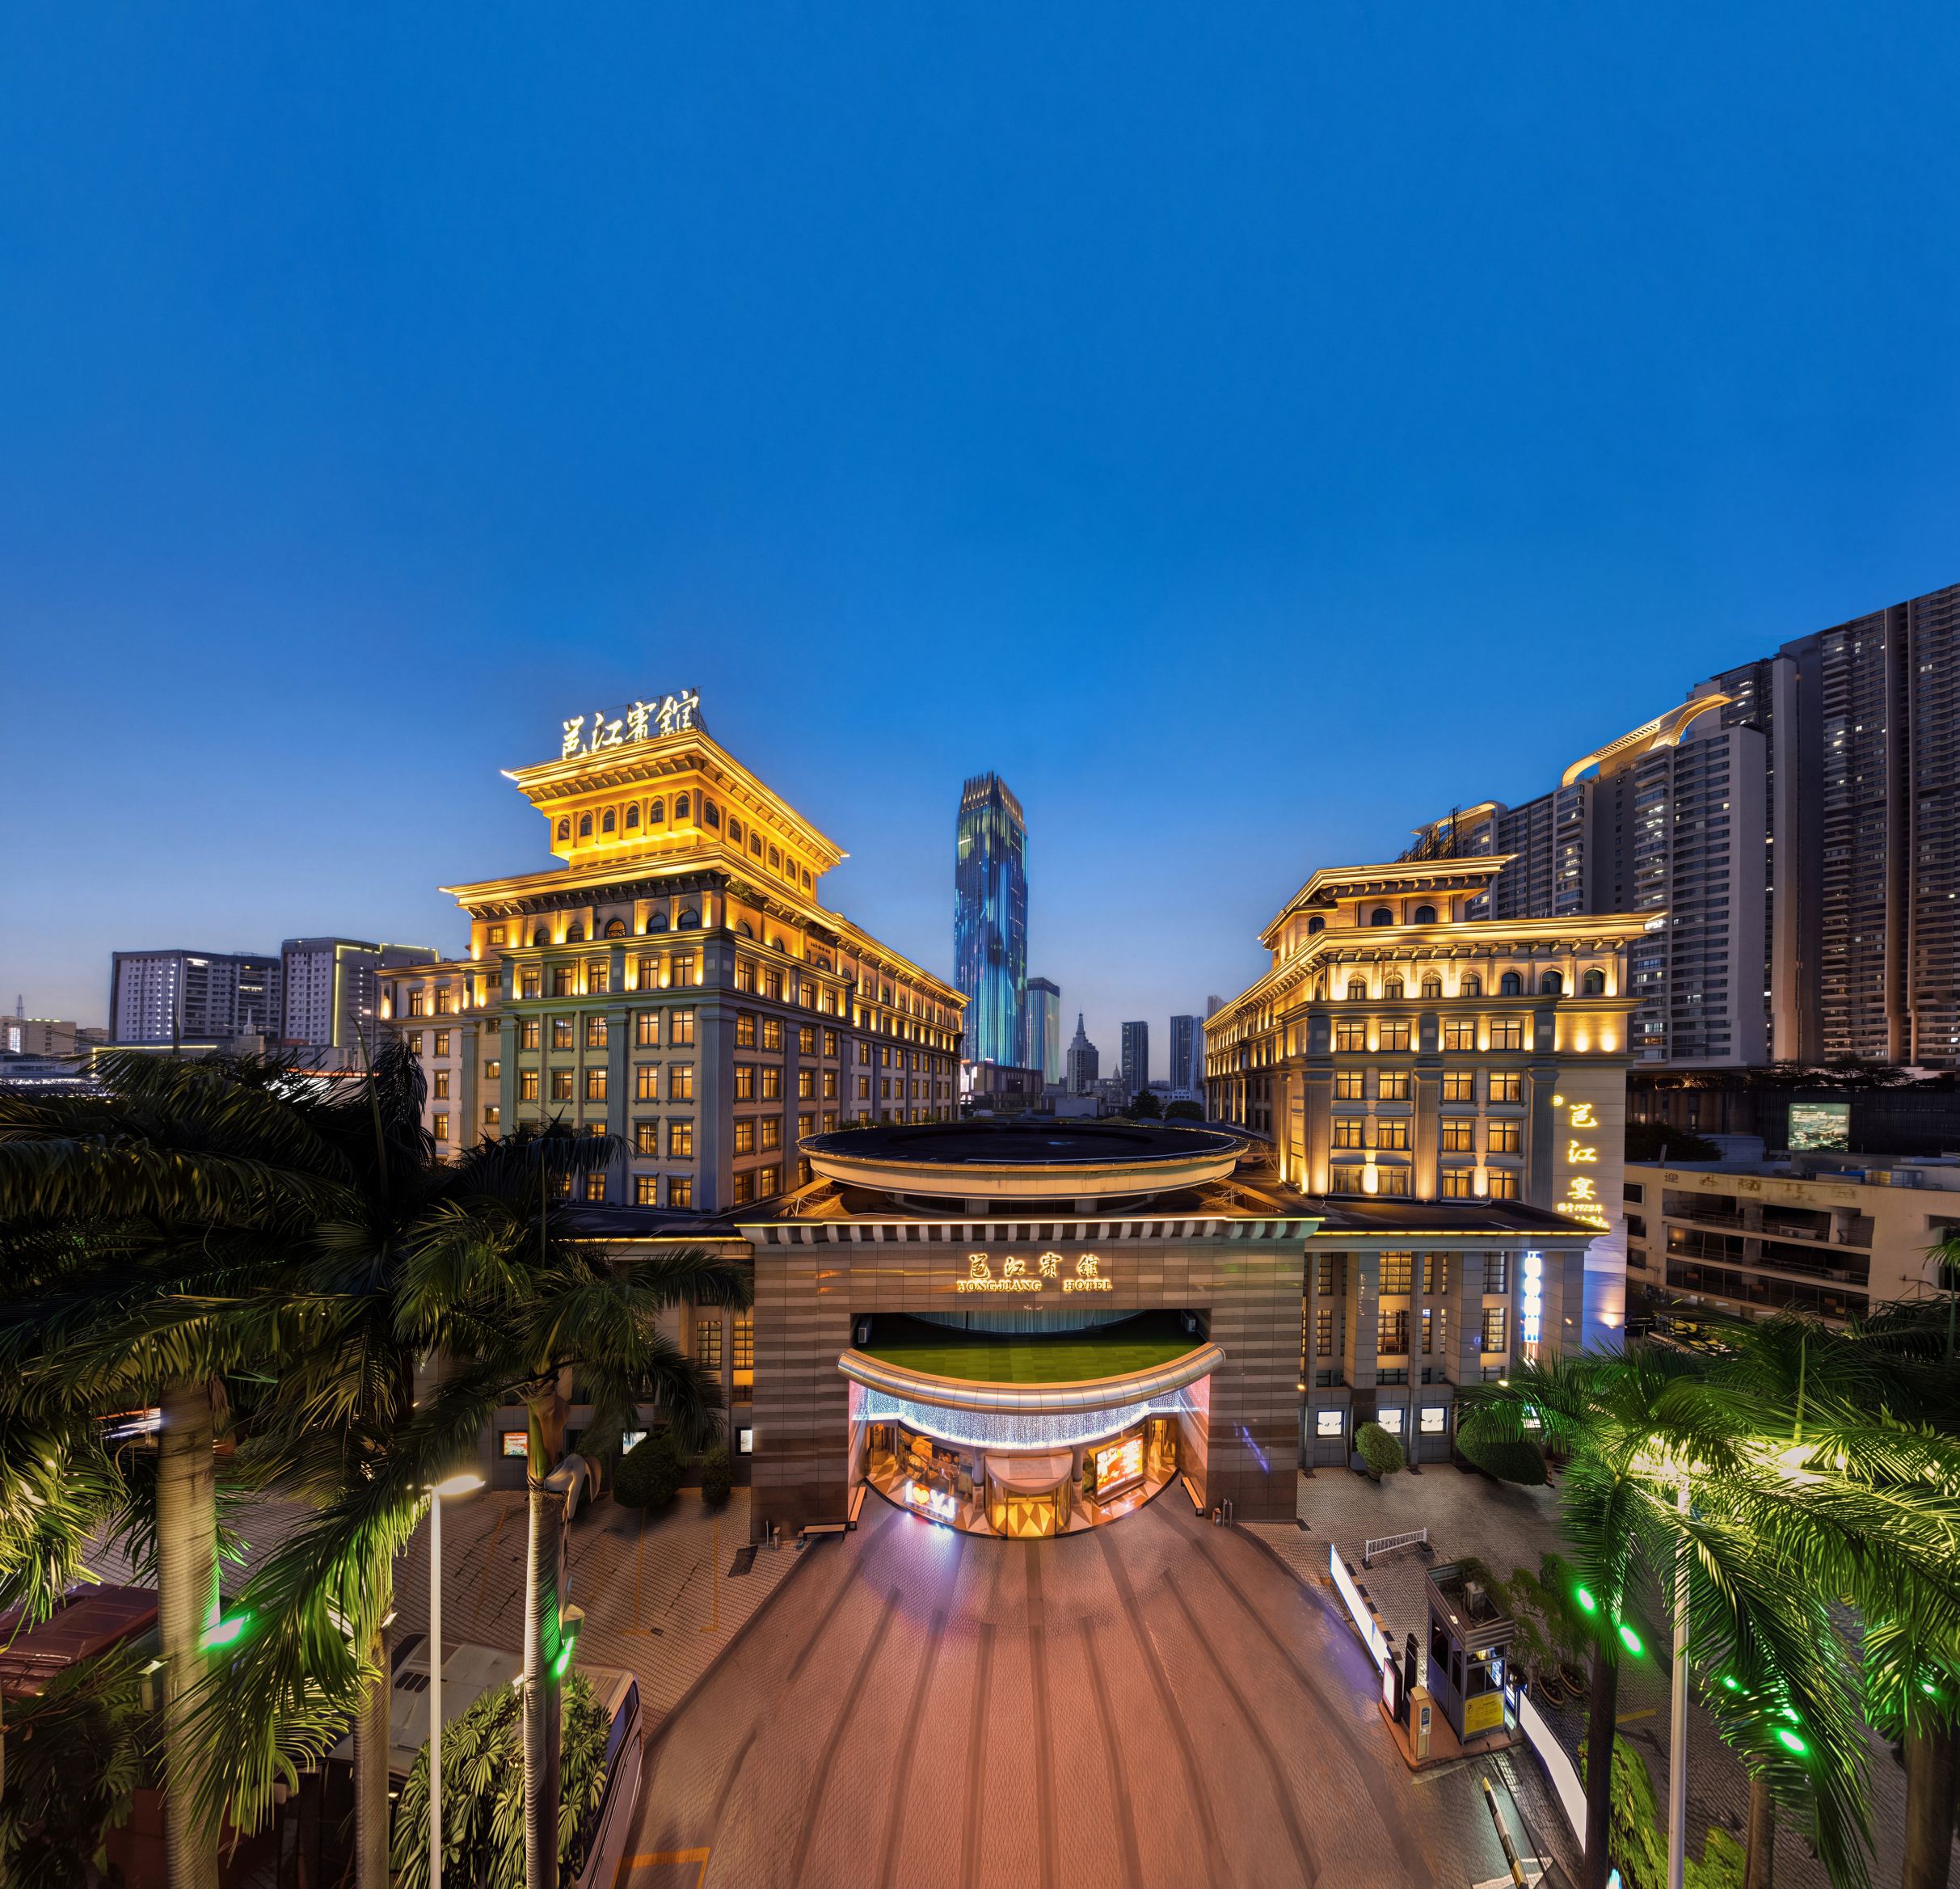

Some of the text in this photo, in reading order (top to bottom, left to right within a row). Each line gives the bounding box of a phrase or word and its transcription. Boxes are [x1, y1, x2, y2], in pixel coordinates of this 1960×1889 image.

[1567, 1104, 1598, 1200] 邕江宴
[956, 1279, 1113, 1293] YONGJIANG HOTEL
